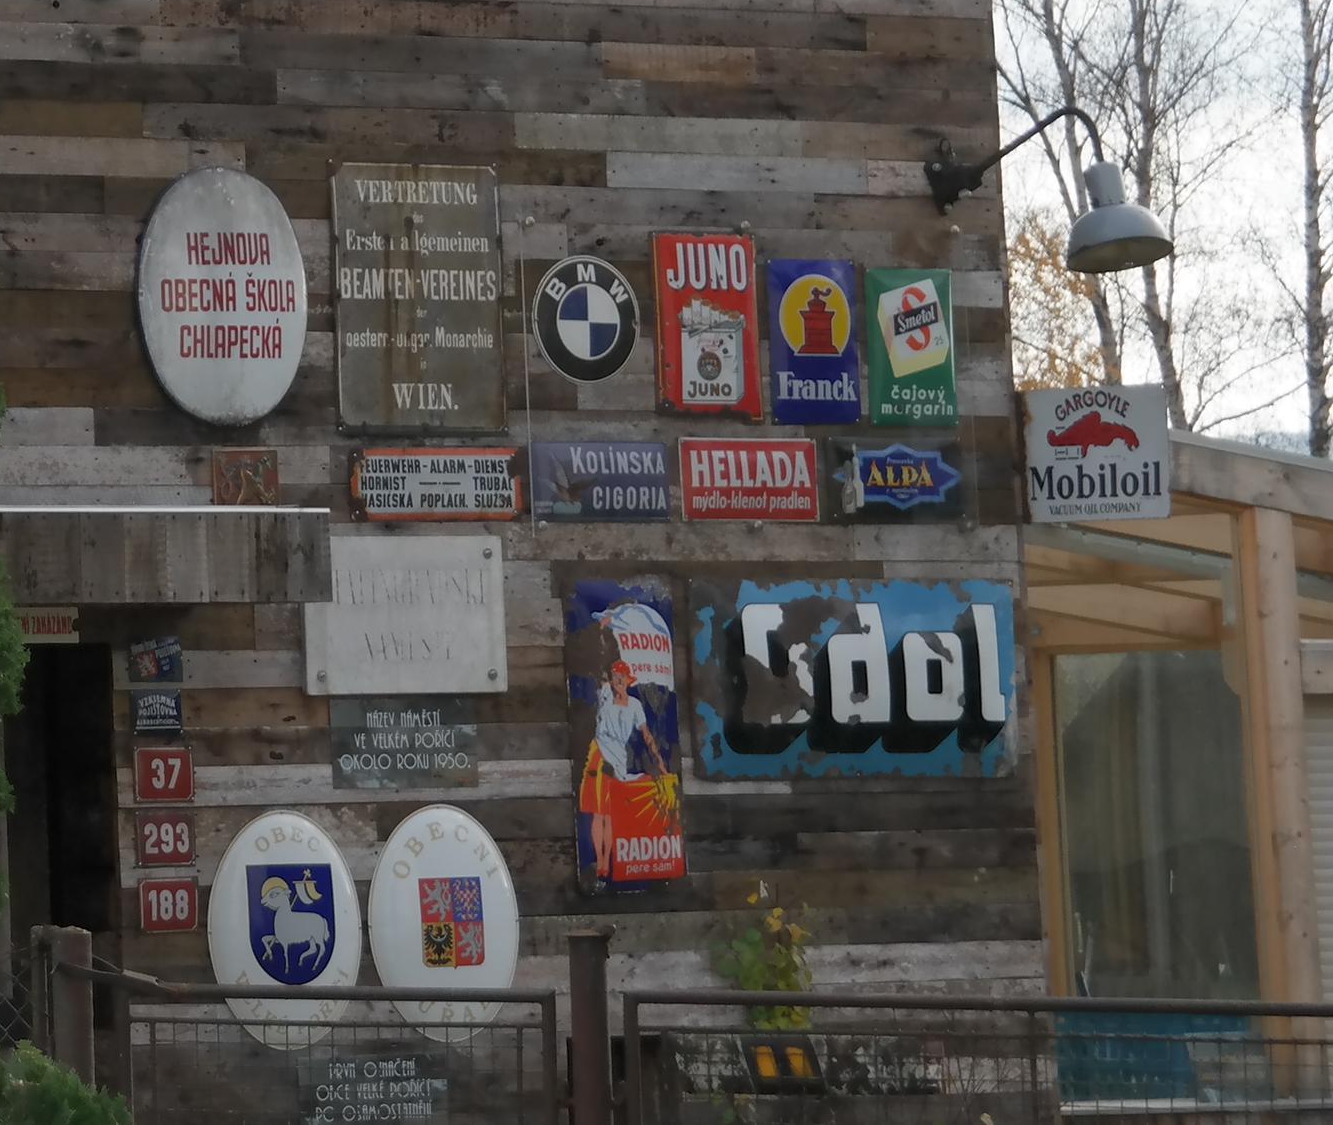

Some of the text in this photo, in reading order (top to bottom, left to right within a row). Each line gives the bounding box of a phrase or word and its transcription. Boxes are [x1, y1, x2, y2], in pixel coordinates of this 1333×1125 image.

[354, 179, 478, 206] VERTRETUNG
[186, 231, 271, 267] HEJNOVA
[399, 228, 490, 258] algemeinen
[666, 242, 748, 291] JUNO
[161, 271, 296, 314] OBECNÁ ŠKOLA
[545, 262, 629, 304] BMW
[897, 304, 936, 333] Smetol
[179, 318, 283, 360] CHLAPECKÁ
[435, 326, 494, 349] Monarchie
[392, 382, 459, 411] WIEN.
[687, 381, 733, 399] JUNO
[777, 371, 858, 402] Franck
[890, 384, 945, 404] čajový
[1054, 390, 1131, 422] GARGOYLE
[360, 476, 407, 491] HORNIST
[688, 449, 812, 489] HELLADA
[866, 459, 934, 488] ALPA
[1029, 461, 1162, 502] Mobiloil
[592, 485, 667, 511] CIGORIA
[769, 491, 812, 514] pradlen
[1049, 503, 1083, 516] VACUUM
[1100, 501, 1142, 514] COMPANY
[619, 632, 671, 654] RADION
[366, 708, 441, 728] NÁZEV NÁMĚSTÍ
[353, 729, 455, 749] VE VELKÉM POŘÍČÍ
[151, 757, 182, 789] 37
[339, 752, 471, 770] OKOLO ROKU 1950.
[144, 822, 190, 855] 293
[254, 825, 321, 853] OBEC
[615, 834, 683, 862] RADION
[626, 864, 650, 876] pere
[148, 888, 189, 921] 188
